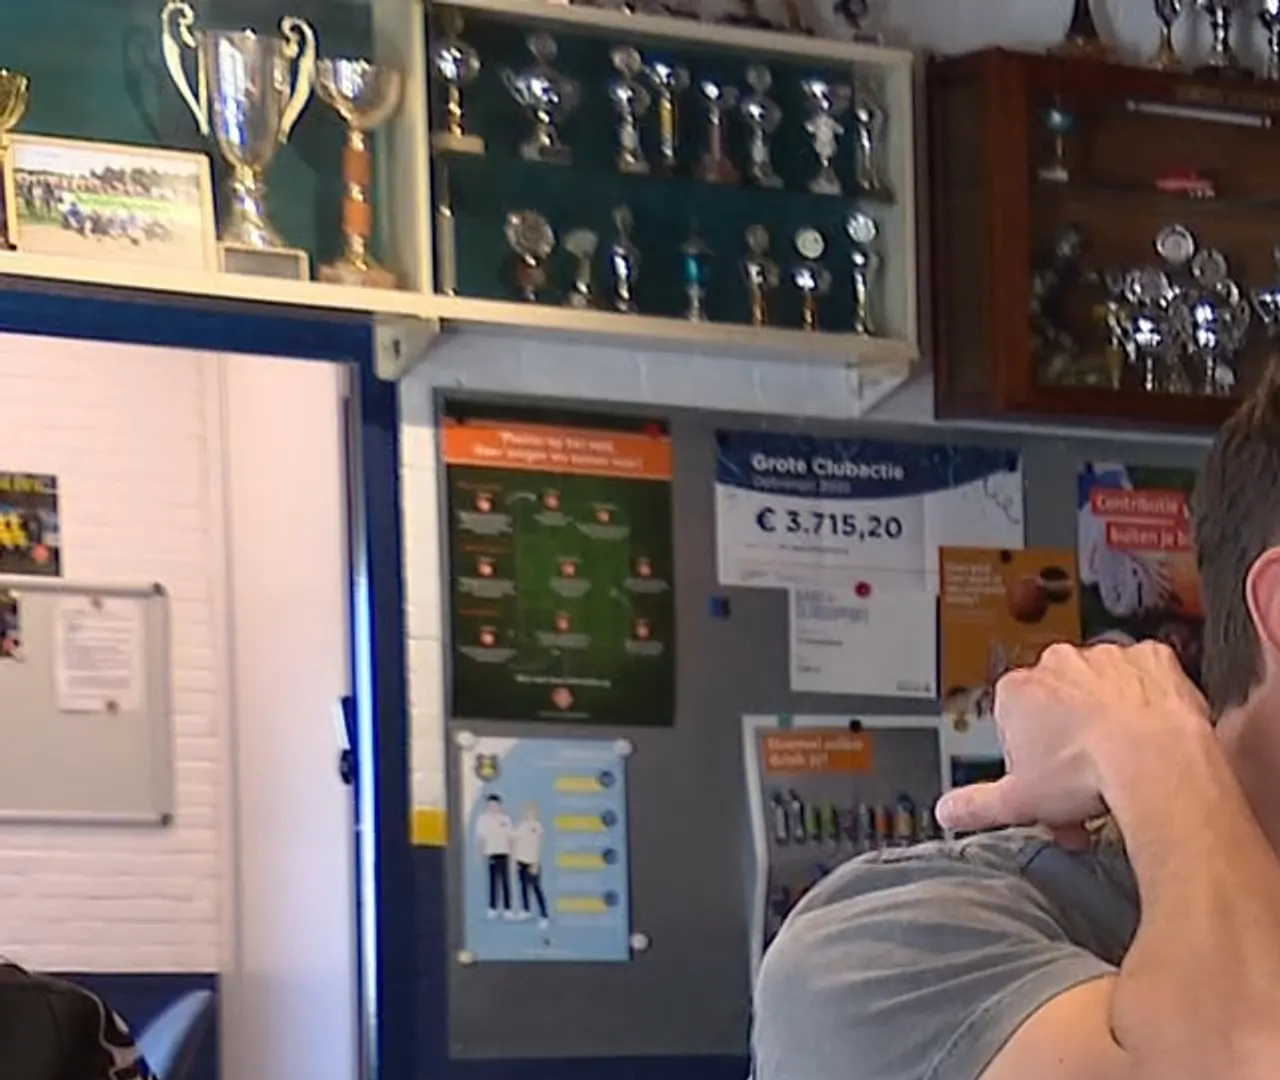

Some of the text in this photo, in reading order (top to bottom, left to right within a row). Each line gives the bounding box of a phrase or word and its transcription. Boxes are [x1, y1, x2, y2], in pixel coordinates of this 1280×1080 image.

[752, 452, 905, 482] Grote Clubactie
[1096, 491, 1179, 514] Contributie
[756, 507, 903, 541] € 3.715,20
